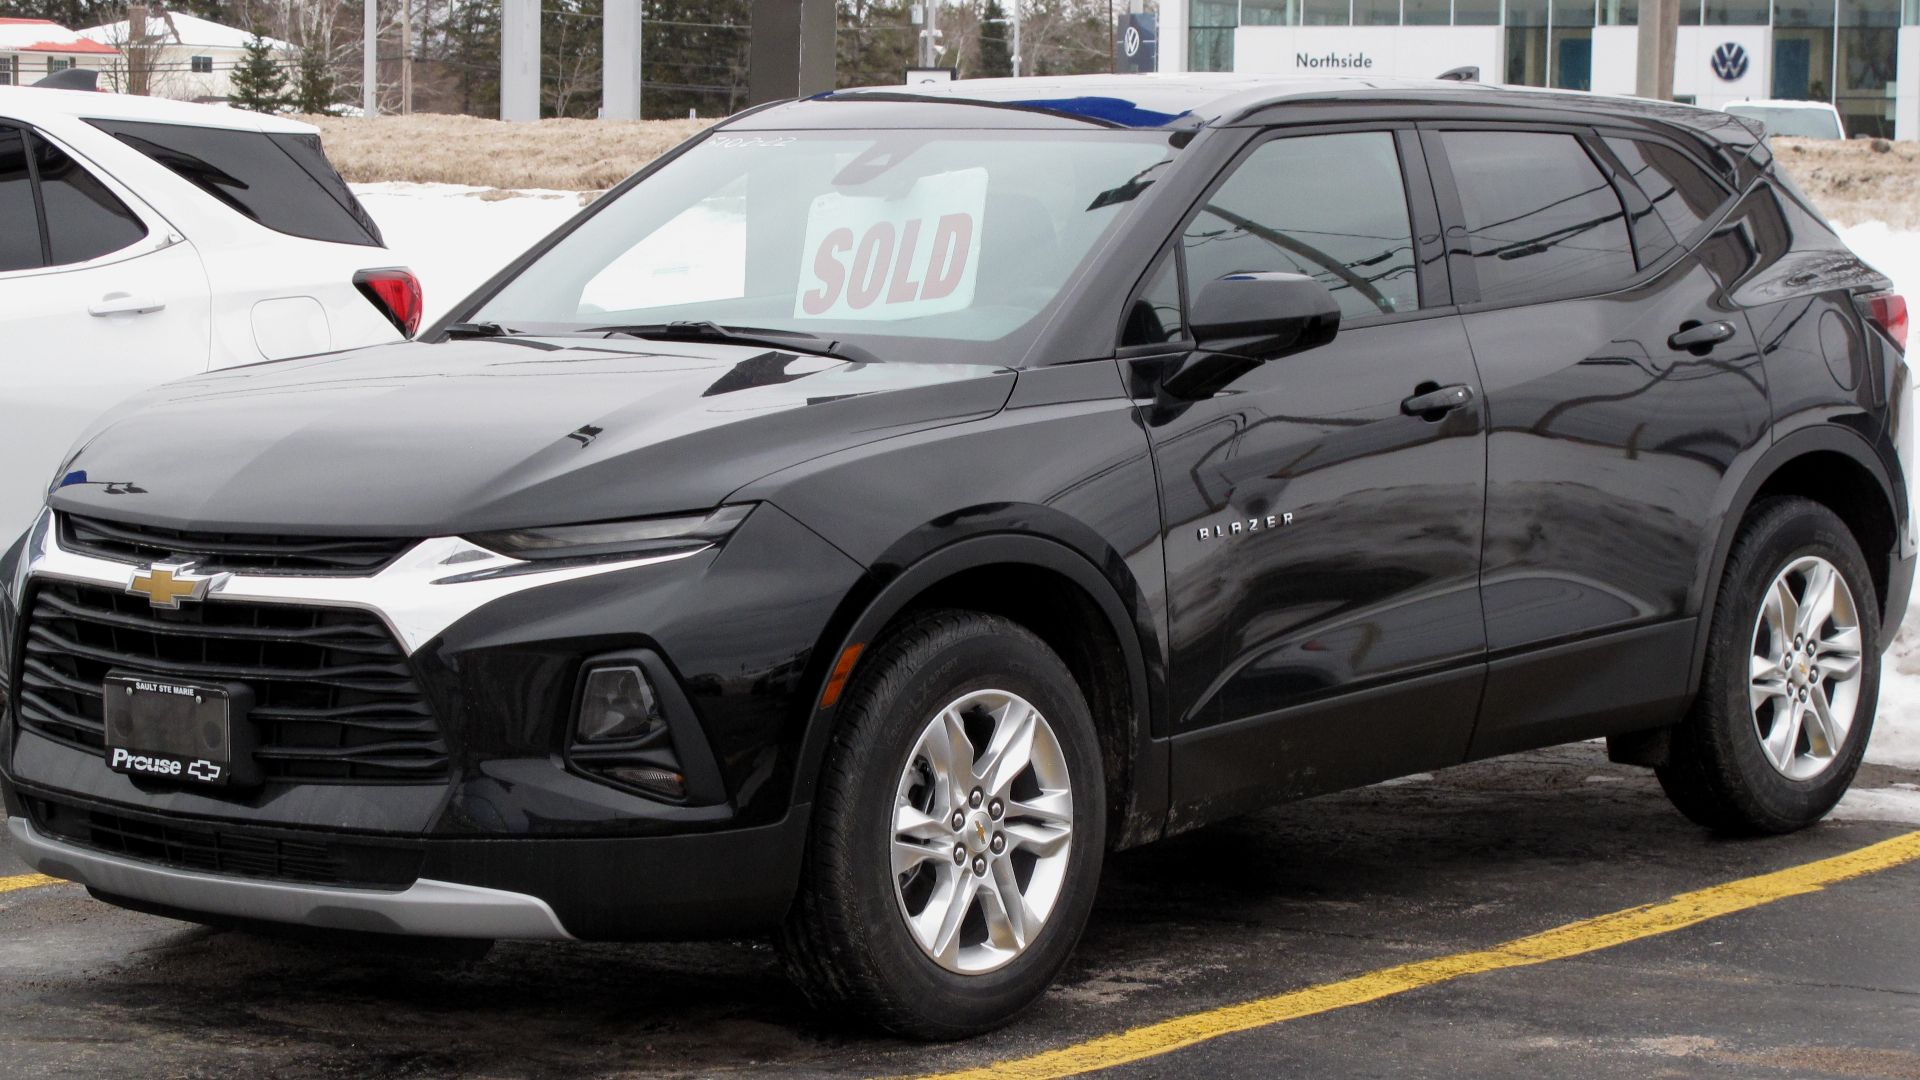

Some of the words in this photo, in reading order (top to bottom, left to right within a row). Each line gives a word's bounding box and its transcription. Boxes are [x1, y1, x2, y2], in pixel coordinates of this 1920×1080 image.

[1296, 52, 1372, 68] Northside
[803, 213, 973, 315] SOLD
[1197, 512, 1293, 541] BLAZER
[135, 682, 157, 692] SAULT
[159, 685, 172, 694] STE
[173, 686, 195, 697] MARIE
[112, 748, 182, 775] Prouse
